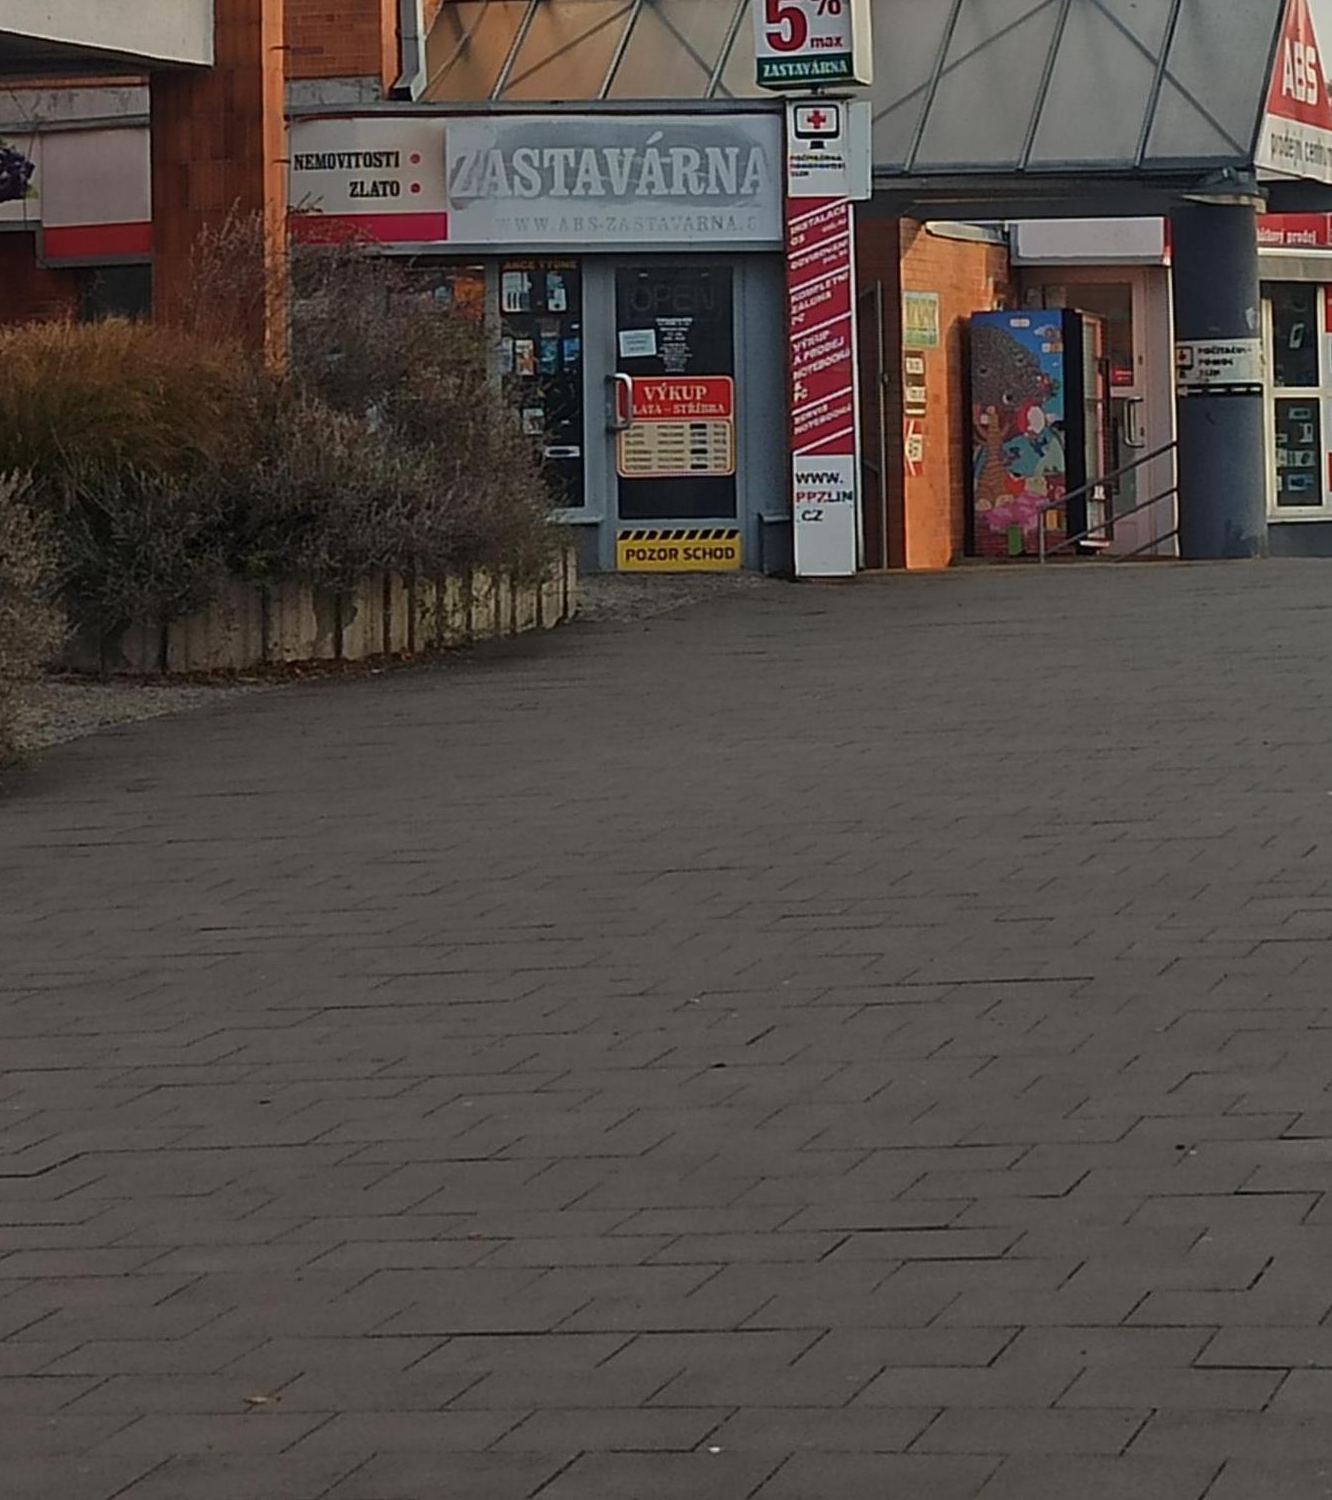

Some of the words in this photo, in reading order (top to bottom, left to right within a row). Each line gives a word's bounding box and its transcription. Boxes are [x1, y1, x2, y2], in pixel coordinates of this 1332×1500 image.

[810, 36, 843, 49] max
[763, 60, 848, 78] ZASTAVÁRNA
[1281, 36, 1318, 106] ABS
[293, 150, 401, 171] NEMOVITOSTI
[449, 130, 769, 201] ZASTAVÁRNA
[348, 181, 401, 198] ZLATO
[643, 382, 708, 401] VÝKUP
[631, 404, 663, 415] LATA
[795, 472, 844, 485] WWW.
[625, 548, 679, 562] POZOR
[682, 546, 736, 561] SCHOD
